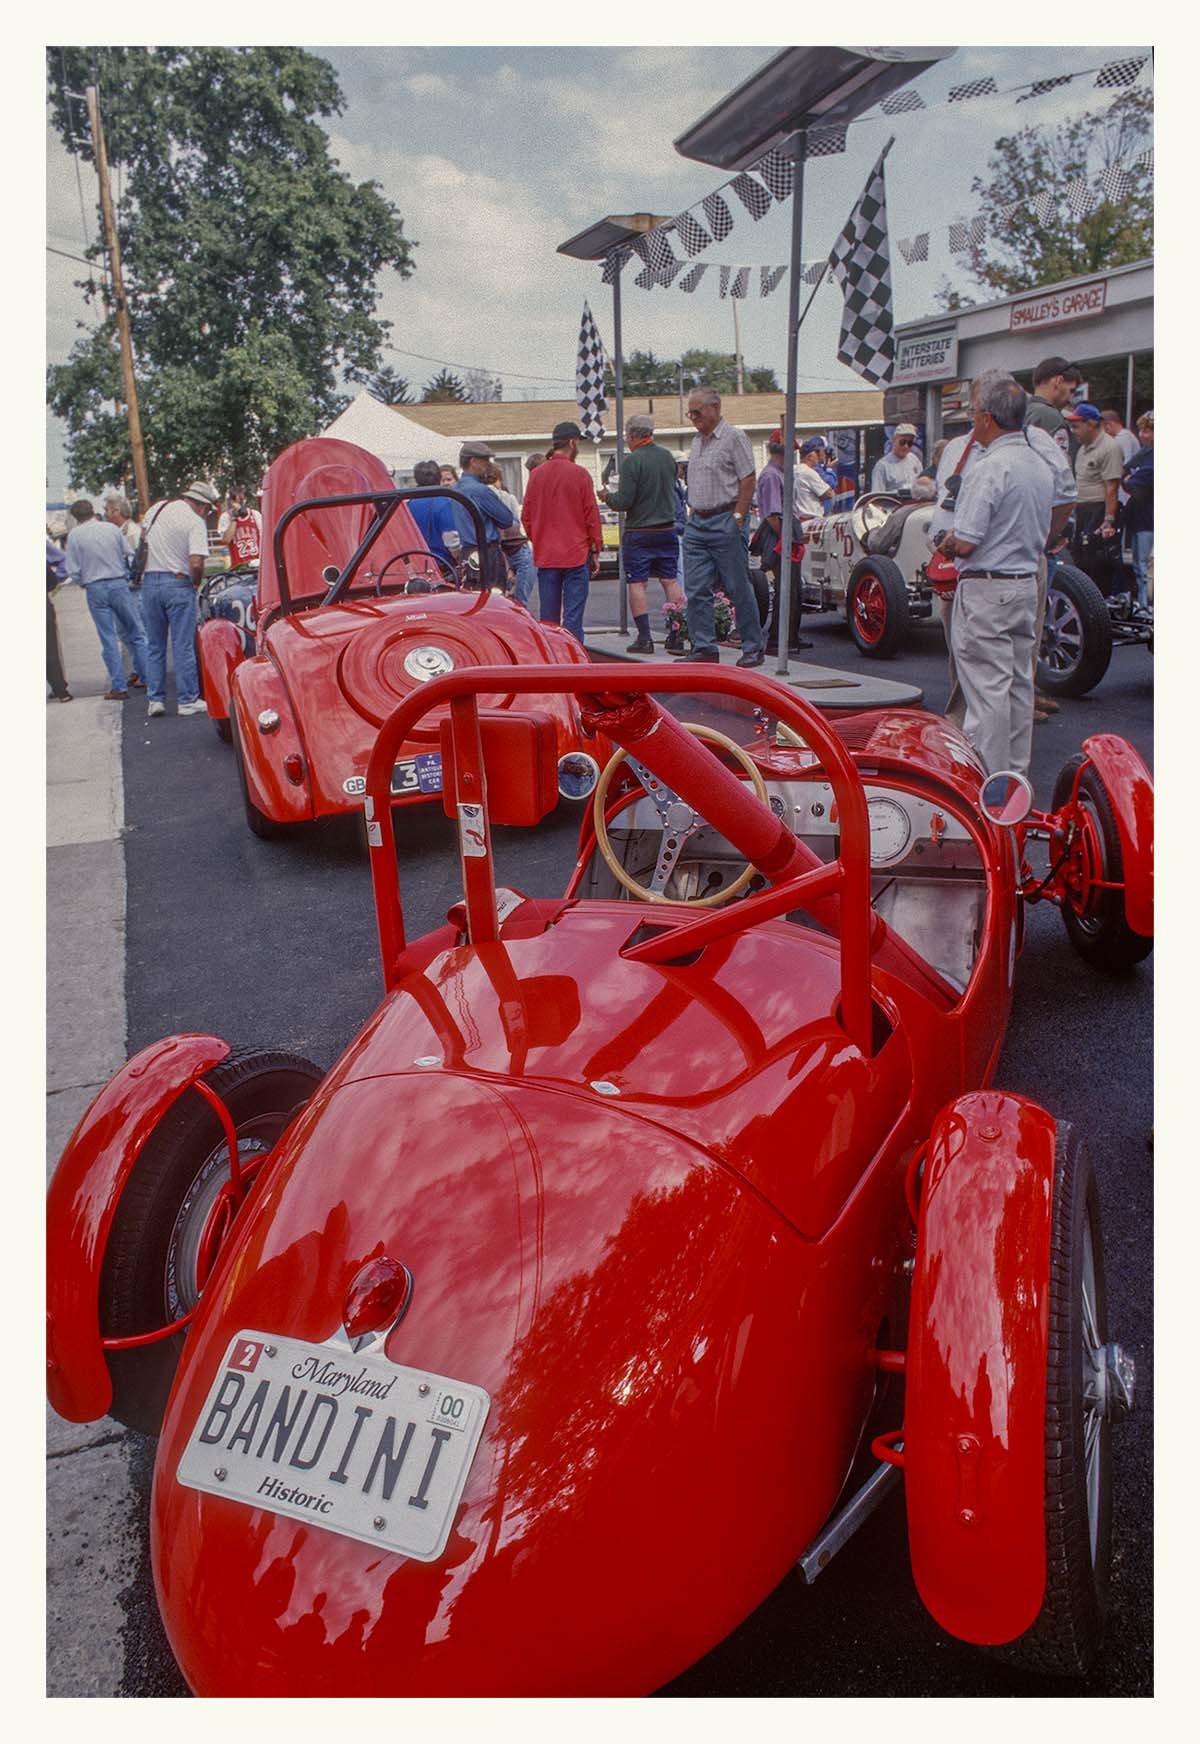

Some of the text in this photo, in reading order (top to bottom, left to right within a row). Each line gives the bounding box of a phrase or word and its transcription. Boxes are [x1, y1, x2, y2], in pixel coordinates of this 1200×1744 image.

[1012, 287, 1102, 326] SMALLEY'S GARAGE
[901, 337, 952, 357] INTERSTATE
[900, 351, 945, 370] BATTERIES
[237, 540, 259, 558] 23
[346, 778, 365, 793] GB
[400, 763, 418, 787] 3
[239, 1343, 258, 1367] 2
[291, 1357, 398, 1400] Maryland
[440, 1395, 464, 1418] 00
[199, 1371, 452, 1510] BANDINI
[257, 1476, 335, 1514] Historic
